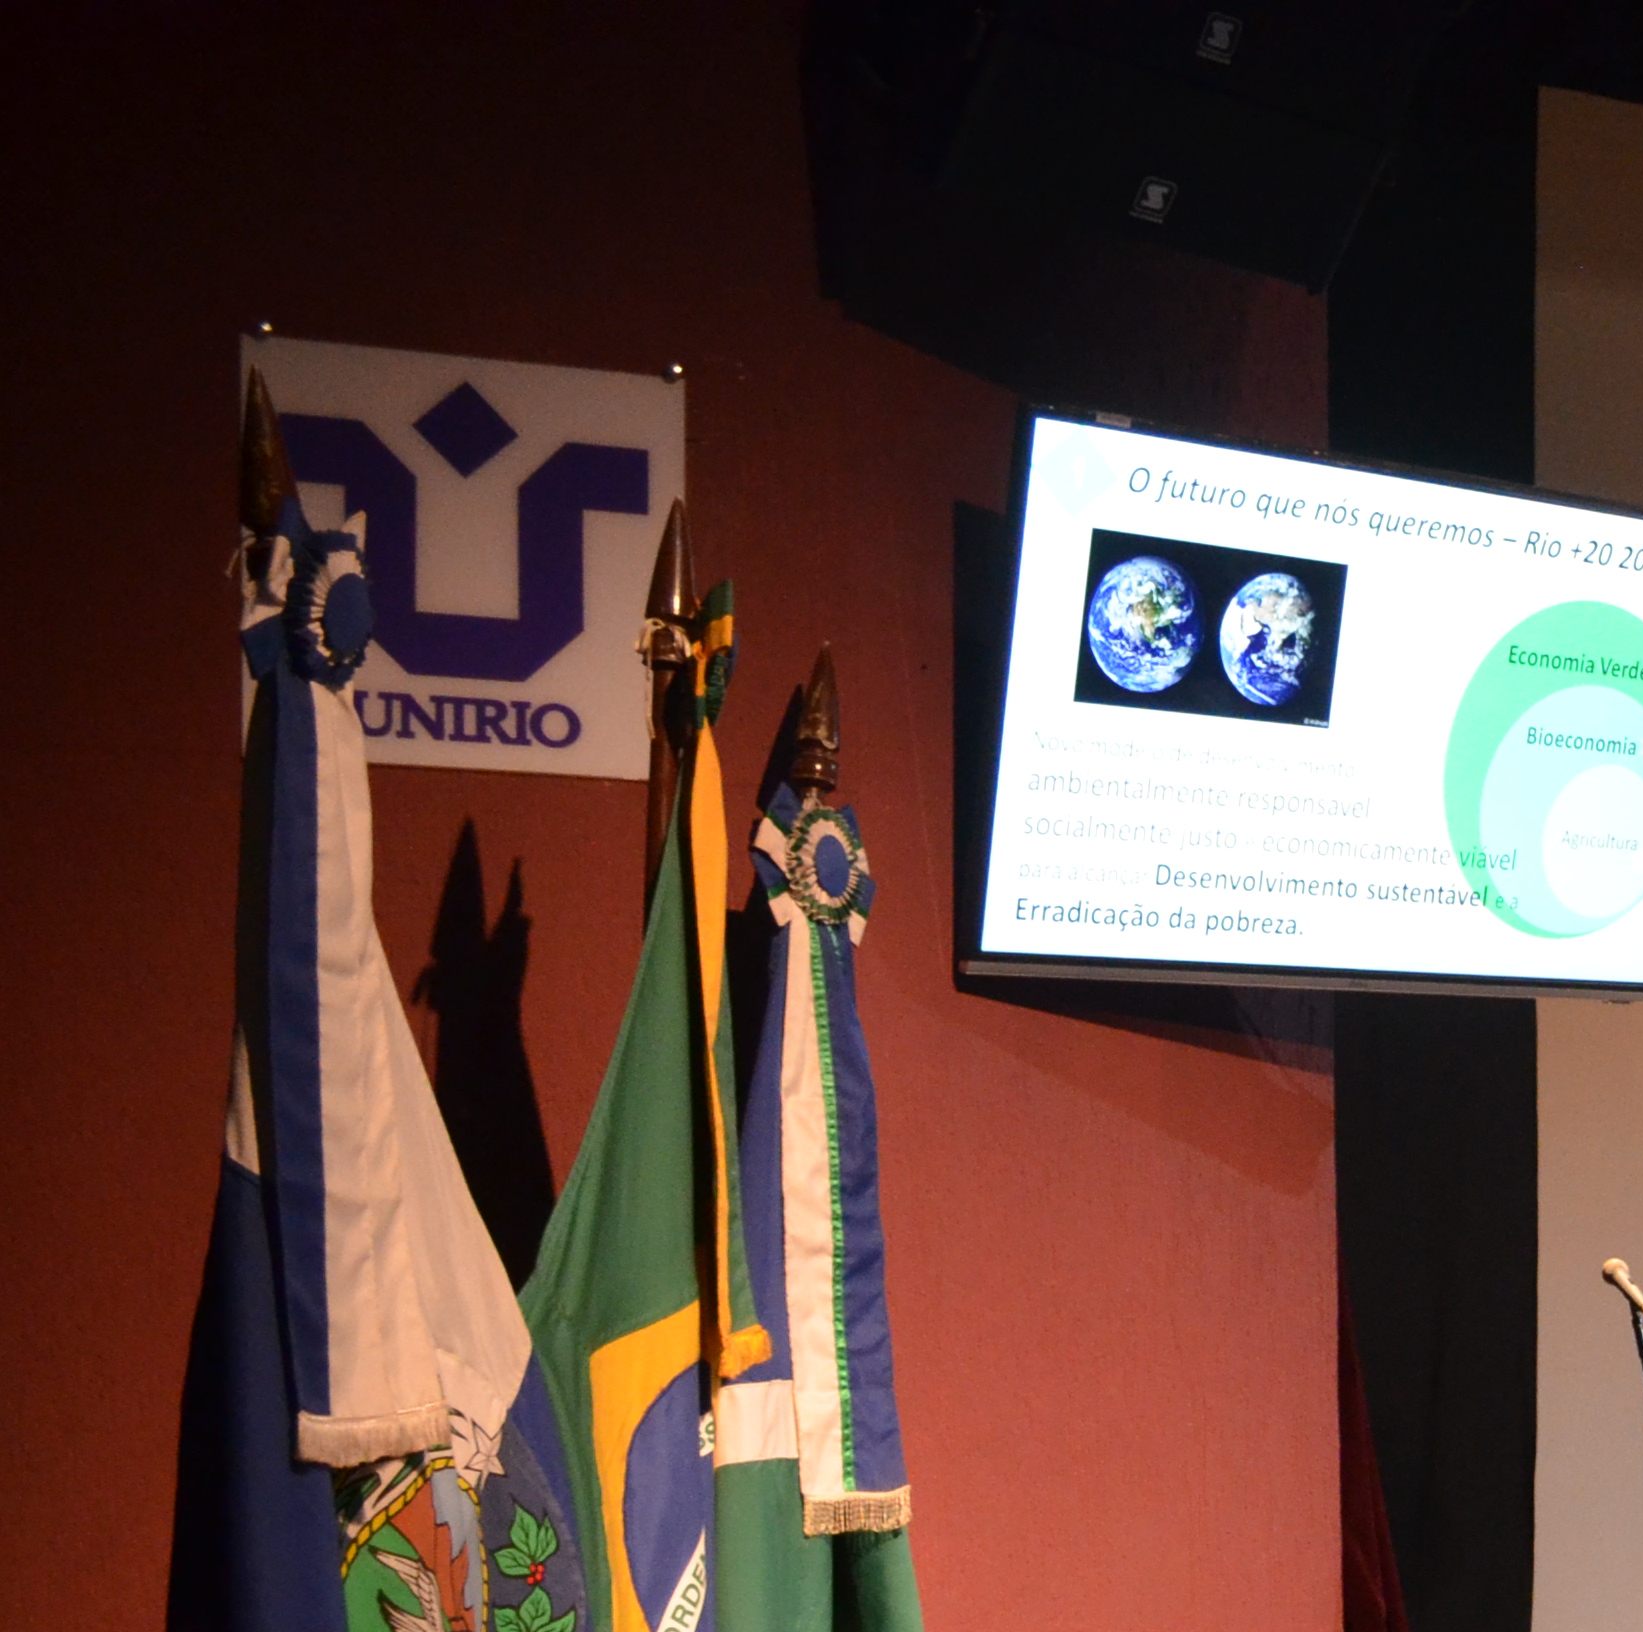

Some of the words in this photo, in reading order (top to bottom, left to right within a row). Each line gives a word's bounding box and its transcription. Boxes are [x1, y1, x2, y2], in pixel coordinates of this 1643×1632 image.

[1154, 470, 1246, 509] futuro
[1256, 493, 1306, 520] que
[1314, 497, 1360, 527] nós
[1368, 511, 1494, 548] queremos
[1524, 530, 1562, 558] Rio
[1571, 540, 1613, 566] +20
[1508, 644, 1595, 674] Economia
[353, 689, 582, 749] UNIRIO
[1090, 739, 1164, 760] modeo
[1526, 726, 1637, 756] Bioeconomia
[1027, 770, 1229, 806] ambientalmente
[1024, 815, 1172, 844] socialmente
[1459, 847, 1517, 871] viável
[1561, 830, 1638, 851] Agricultura
[1155, 863, 1358, 899] Desenvolvimento
[1367, 882, 1487, 906] sustentável
[1015, 897, 1160, 932] Erradicação
[1168, 906, 1196, 929] da
[1205, 911, 1304, 936] pobreza.
